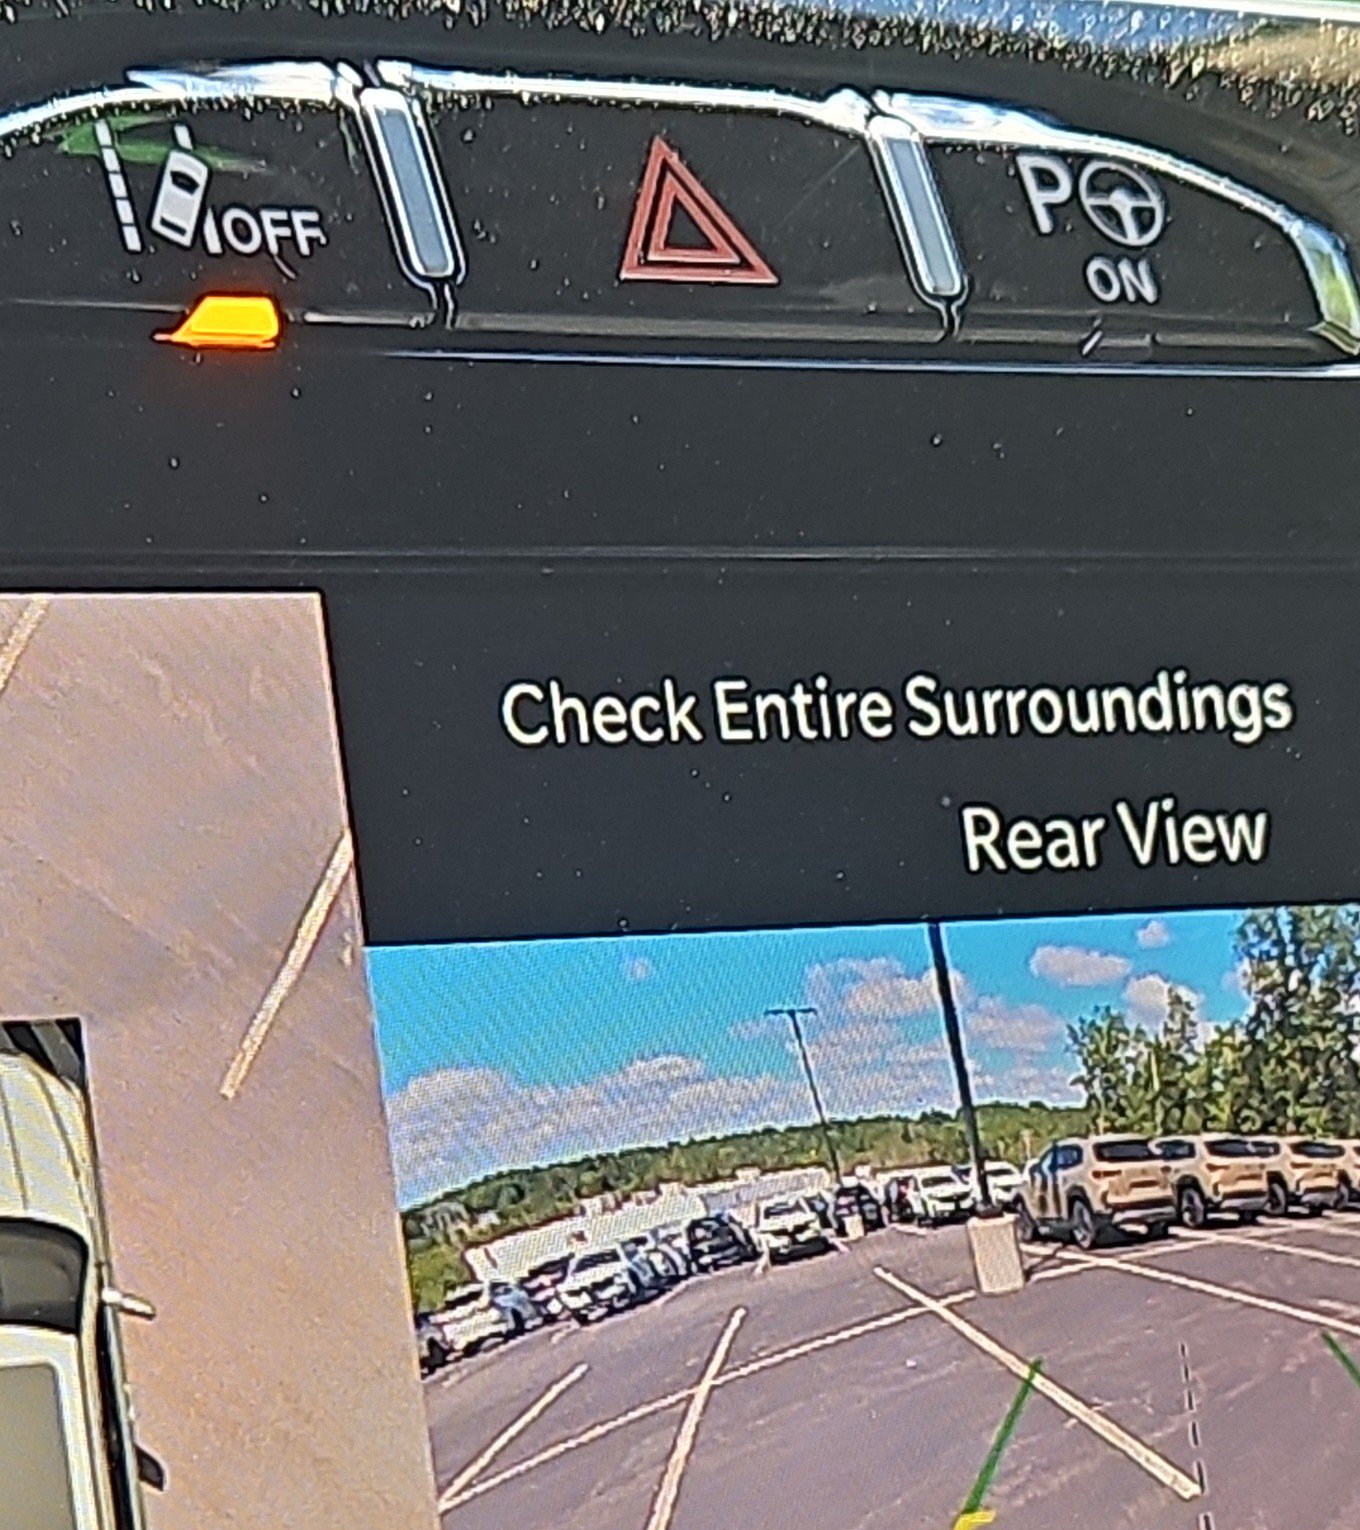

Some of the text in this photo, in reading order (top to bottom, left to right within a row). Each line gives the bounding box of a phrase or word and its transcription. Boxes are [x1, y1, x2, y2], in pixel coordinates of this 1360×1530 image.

[221, 207, 324, 256] OFF
[1086, 255, 1158, 303] ON
[502, 671, 1293, 745] Check Entire Surroundings
[962, 800, 1268, 873] Rear View
